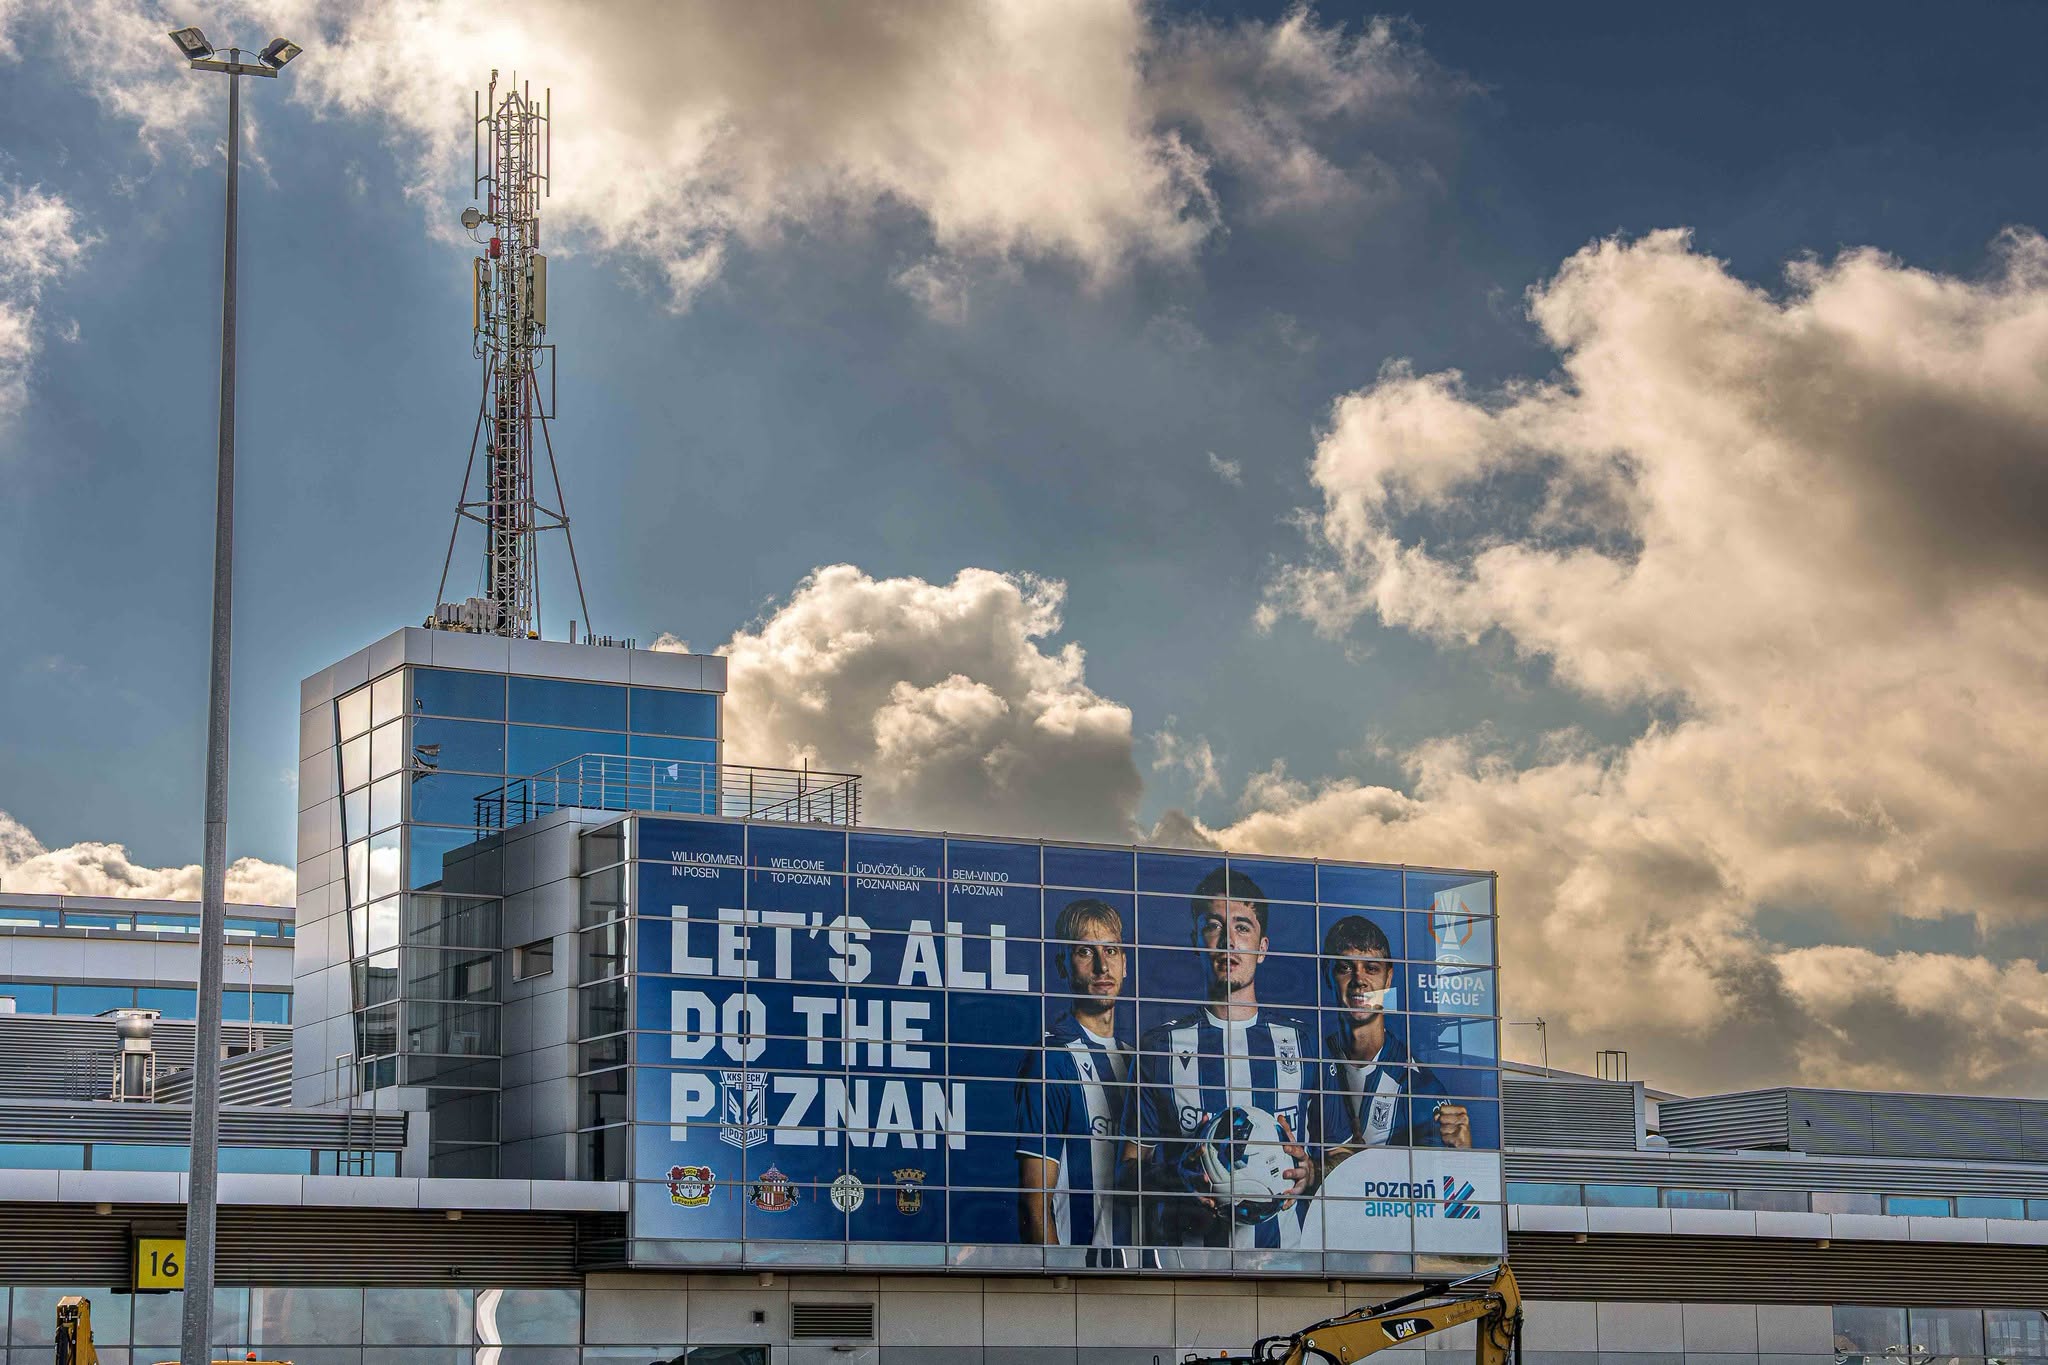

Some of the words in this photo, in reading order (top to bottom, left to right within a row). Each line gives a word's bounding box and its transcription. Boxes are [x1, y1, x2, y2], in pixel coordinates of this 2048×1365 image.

[672, 851, 743, 865] WILLKOMMEN
[771, 857, 824, 871] WELCOME
[672, 865, 682, 877] IN
[684, 866, 719, 879] POSEN
[856, 861, 926, 877] ÜDVÖZÖLJÜK
[952, 869, 1009, 883] BEM-VINDO
[771, 872, 786, 884] TO
[787, 873, 831, 886] POZNAN
[856, 878, 920, 892] POZNANBAN
[952, 884, 960, 895] A
[961, 884, 1003, 897] POZNAN
[672, 905, 871, 983] LET'S
[898, 919, 1029, 991] ALL
[1418, 974, 1486, 992] EUROPA
[1424, 991, 1480, 1006] LEAGUE
[671, 990, 766, 1062] DO
[793, 996, 931, 1069] THE
[727, 1073, 742, 1081] KKS
[745, 1074, 760, 1082] ECH
[729, 1128, 758, 1140] POZAN
[150, 1251, 179, 1277] 16
[1395, 1319, 1417, 1338] CAT
